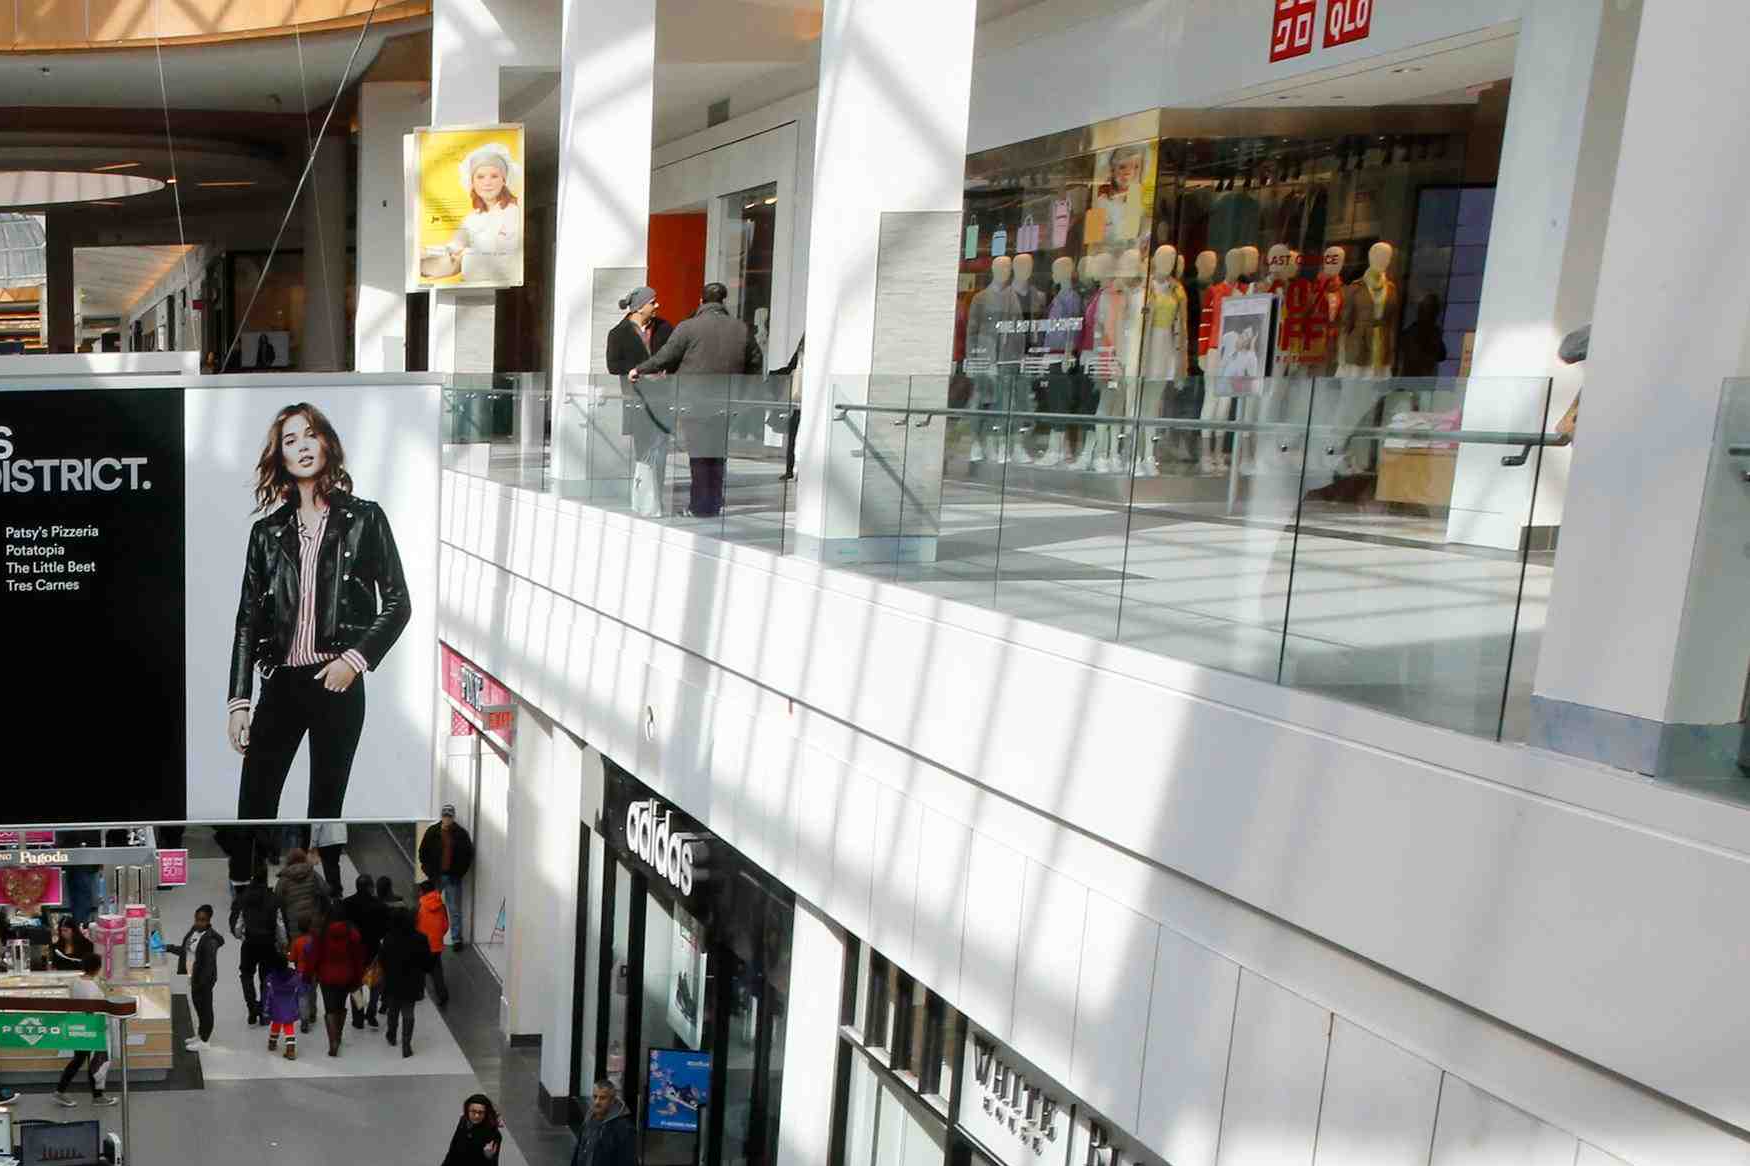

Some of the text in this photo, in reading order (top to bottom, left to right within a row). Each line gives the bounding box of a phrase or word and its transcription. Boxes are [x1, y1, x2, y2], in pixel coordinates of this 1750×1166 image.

[5, 524, 99, 540] Patsy's Pizzeria
[6, 543, 65, 558] Potatopia
[5, 560, 96, 573] The Little Beet
[5, 578, 80, 591] Tres Carnes
[626, 798, 694, 896] adidas
[19, 850, 69, 865] Pagoda
[2, 1025, 61, 1034] PETRO
[974, 1038, 1057, 1134] WHITE
